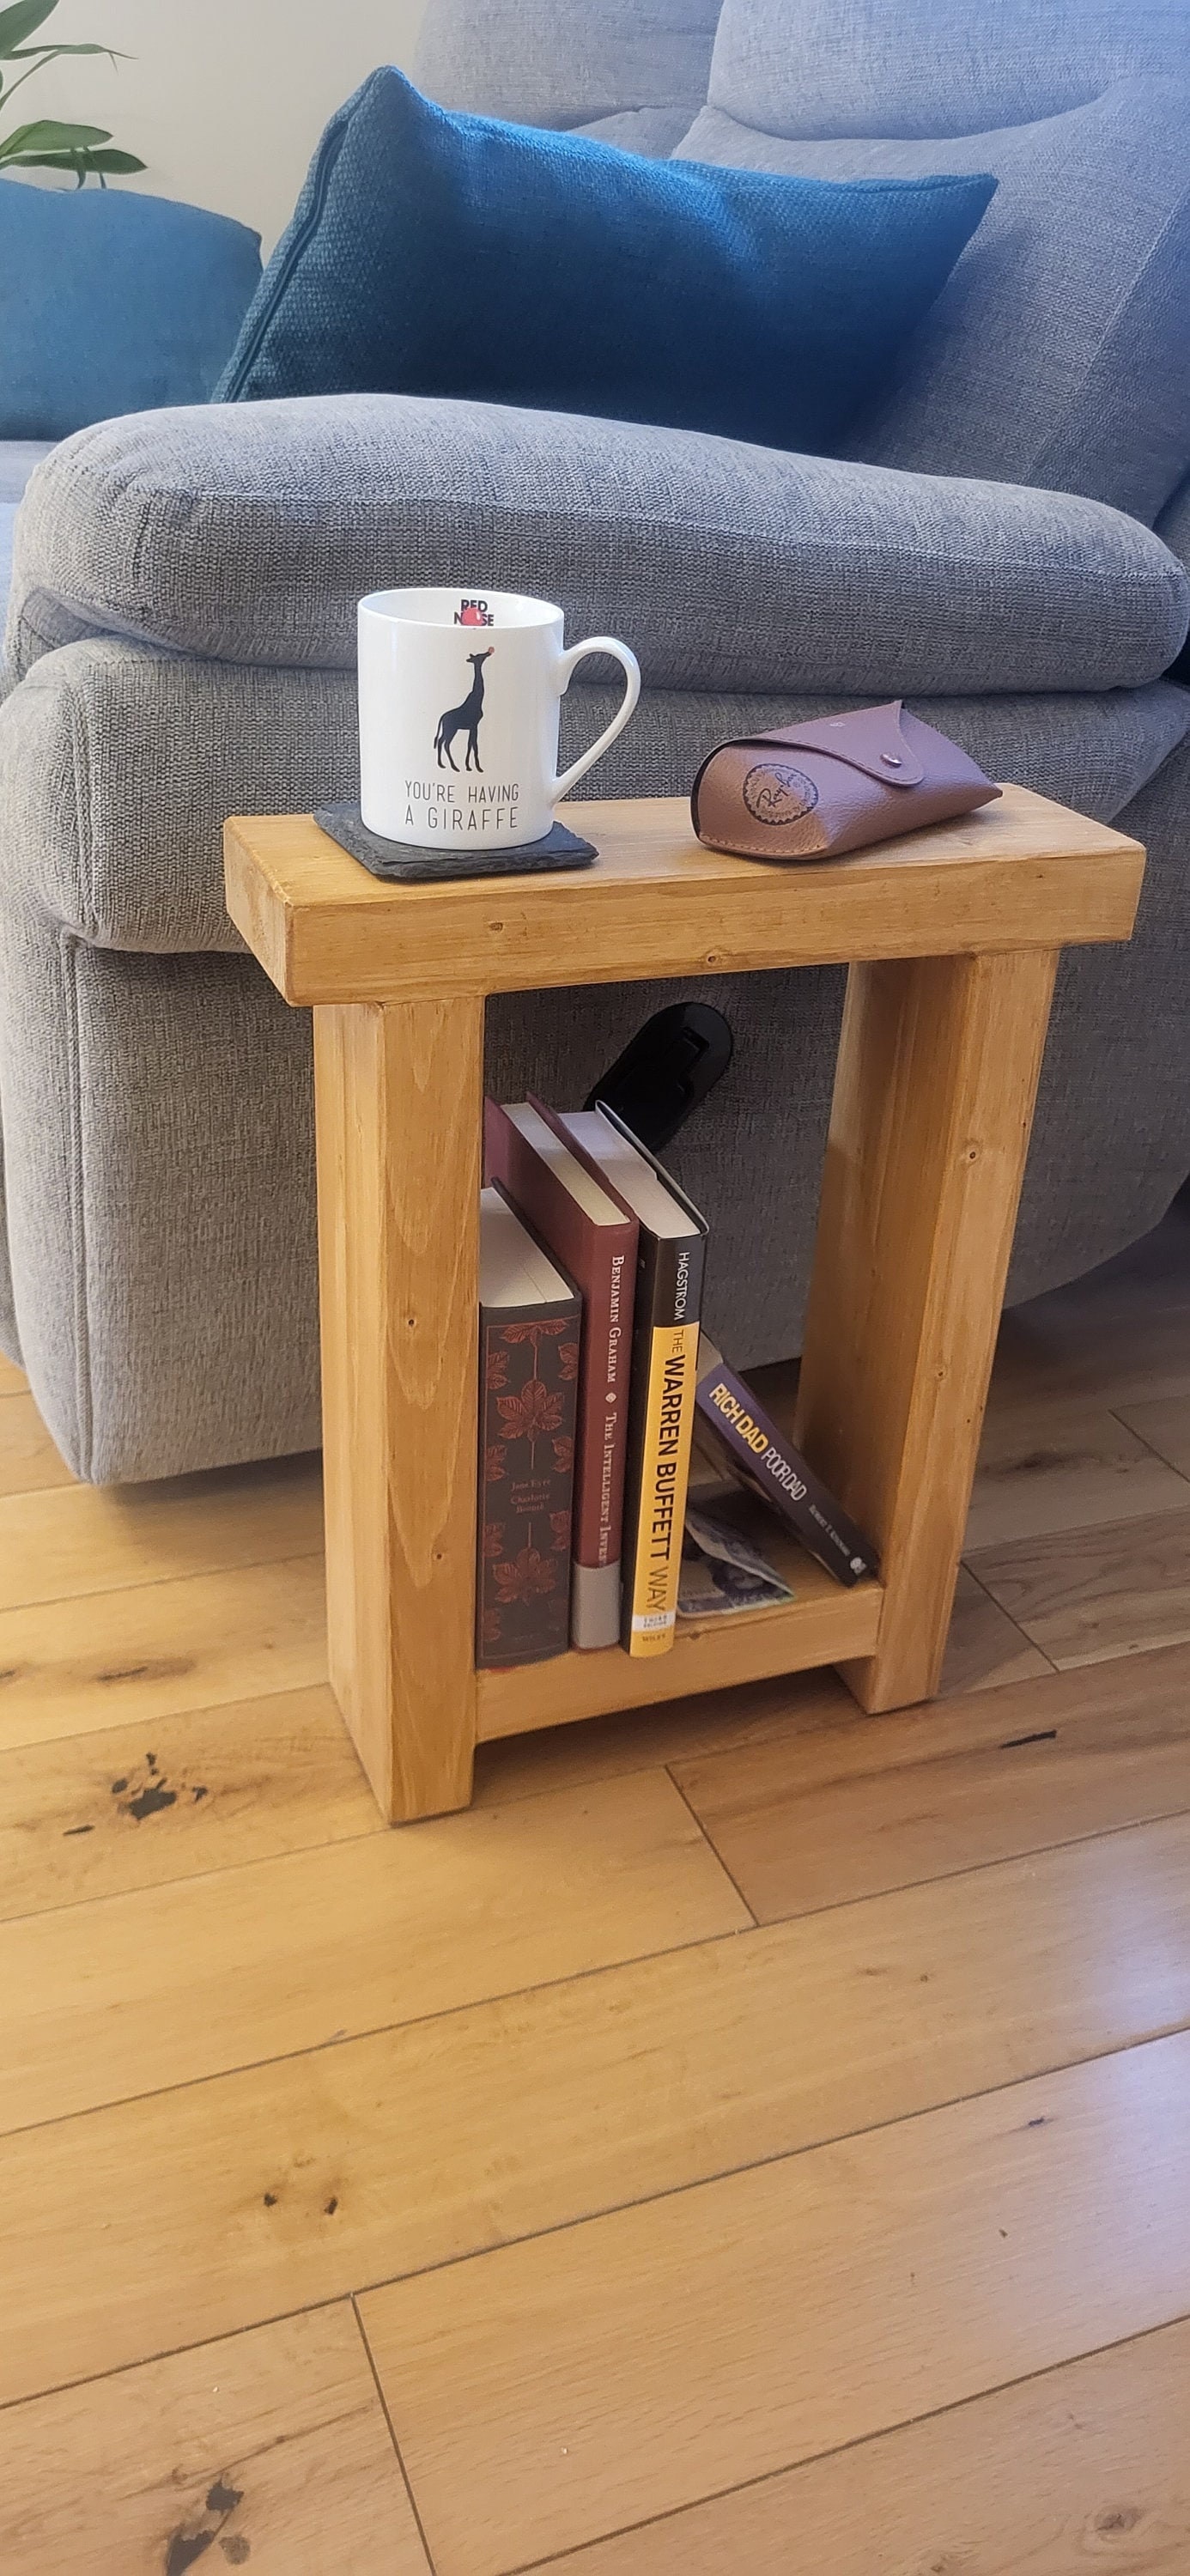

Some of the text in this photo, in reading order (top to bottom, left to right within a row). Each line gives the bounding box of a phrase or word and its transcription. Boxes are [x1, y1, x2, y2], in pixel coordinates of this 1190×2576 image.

[461, 599, 488, 612] RED
[405, 780, 519, 804] YOU'RE HAVING
[405, 804, 519, 830] A GIRAFFE
[607, 1255, 625, 1382] BENJAMIN GRAHAM
[673, 1252, 690, 1321] HAGSTROM
[604, 1413, 617, 1441] THE
[708, 1382, 745, 1424] RICH
[735, 1415, 769, 1454] DAD
[601, 1443, 615, 1523] INTELLIGENT
[646, 1329, 687, 1611] THE WARREN BUFFETT WAY
